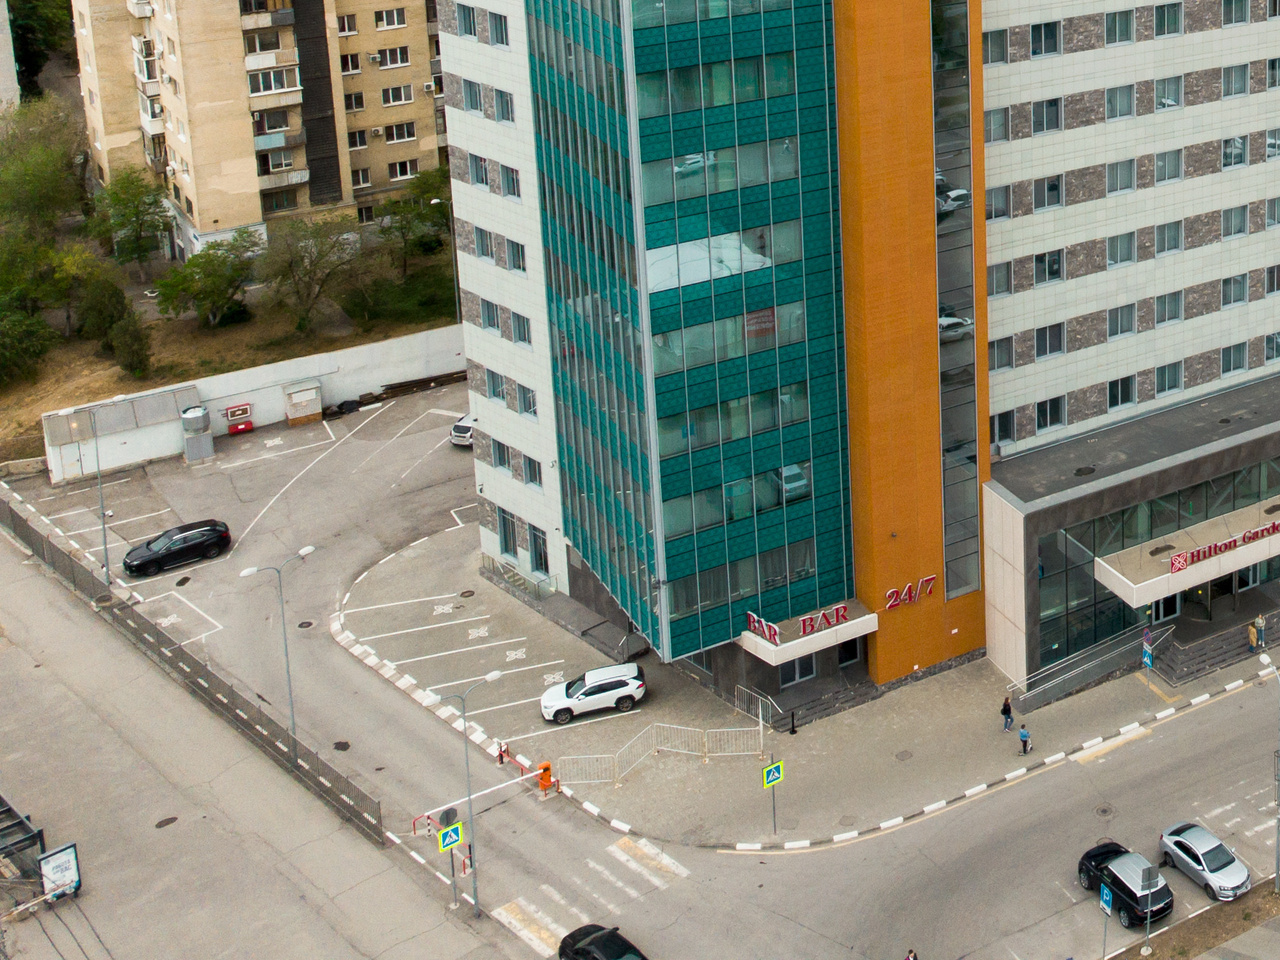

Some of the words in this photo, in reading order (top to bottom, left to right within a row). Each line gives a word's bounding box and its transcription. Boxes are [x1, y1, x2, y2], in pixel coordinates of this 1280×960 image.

[1189, 538, 1237, 564] Hilton
[885, 574, 937, 610] 24/7
[747, 611, 780, 646] BAR
[799, 604, 850, 636] BAR
